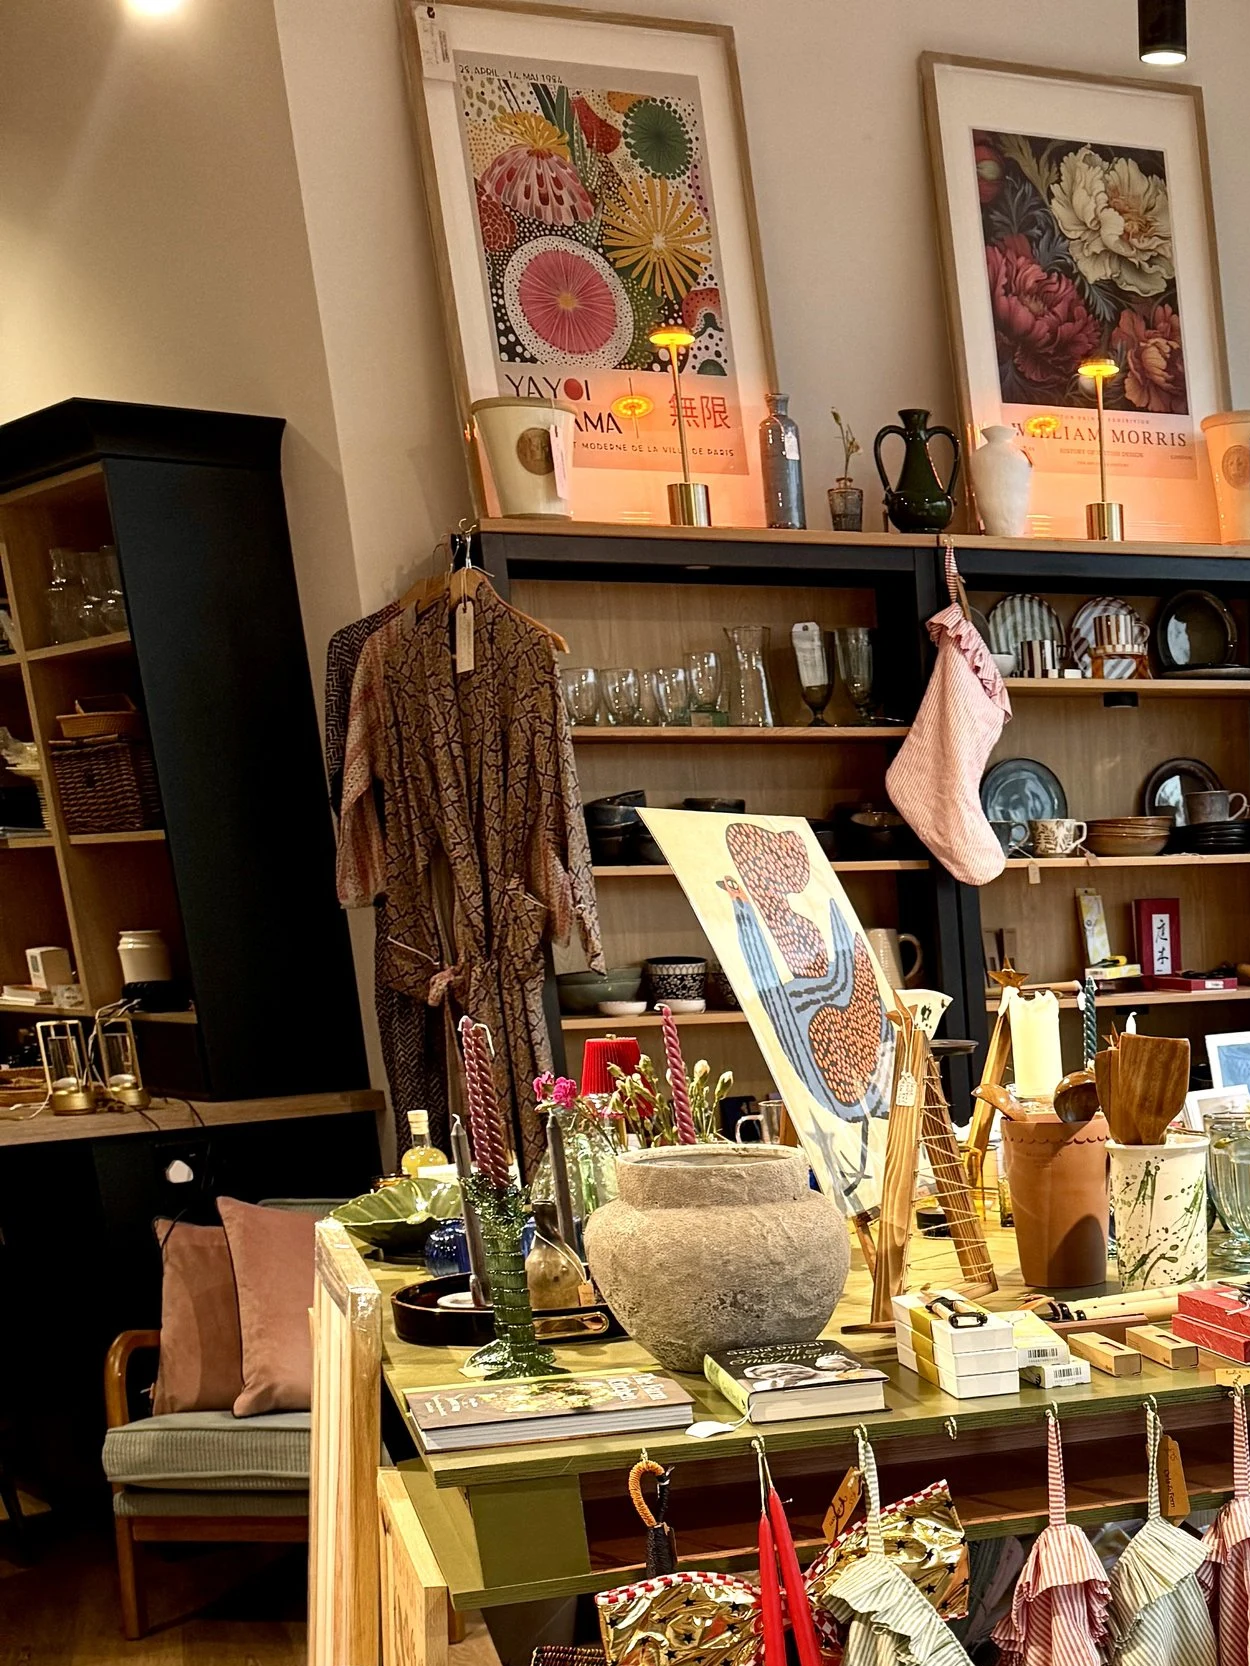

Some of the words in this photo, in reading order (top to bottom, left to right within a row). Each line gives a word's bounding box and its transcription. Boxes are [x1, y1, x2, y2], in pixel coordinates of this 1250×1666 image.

[474, 67, 499, 78] APRIL
[505, 373, 591, 401] YAYOI
[1112, 429, 1187, 447] MORRIS
[582, 442, 628, 452] MODERNE
[631, 444, 643, 453] DE
[647, 446, 659, 454] LA
[692, 448, 704, 456] DE
[707, 449, 735, 457] PARIS
